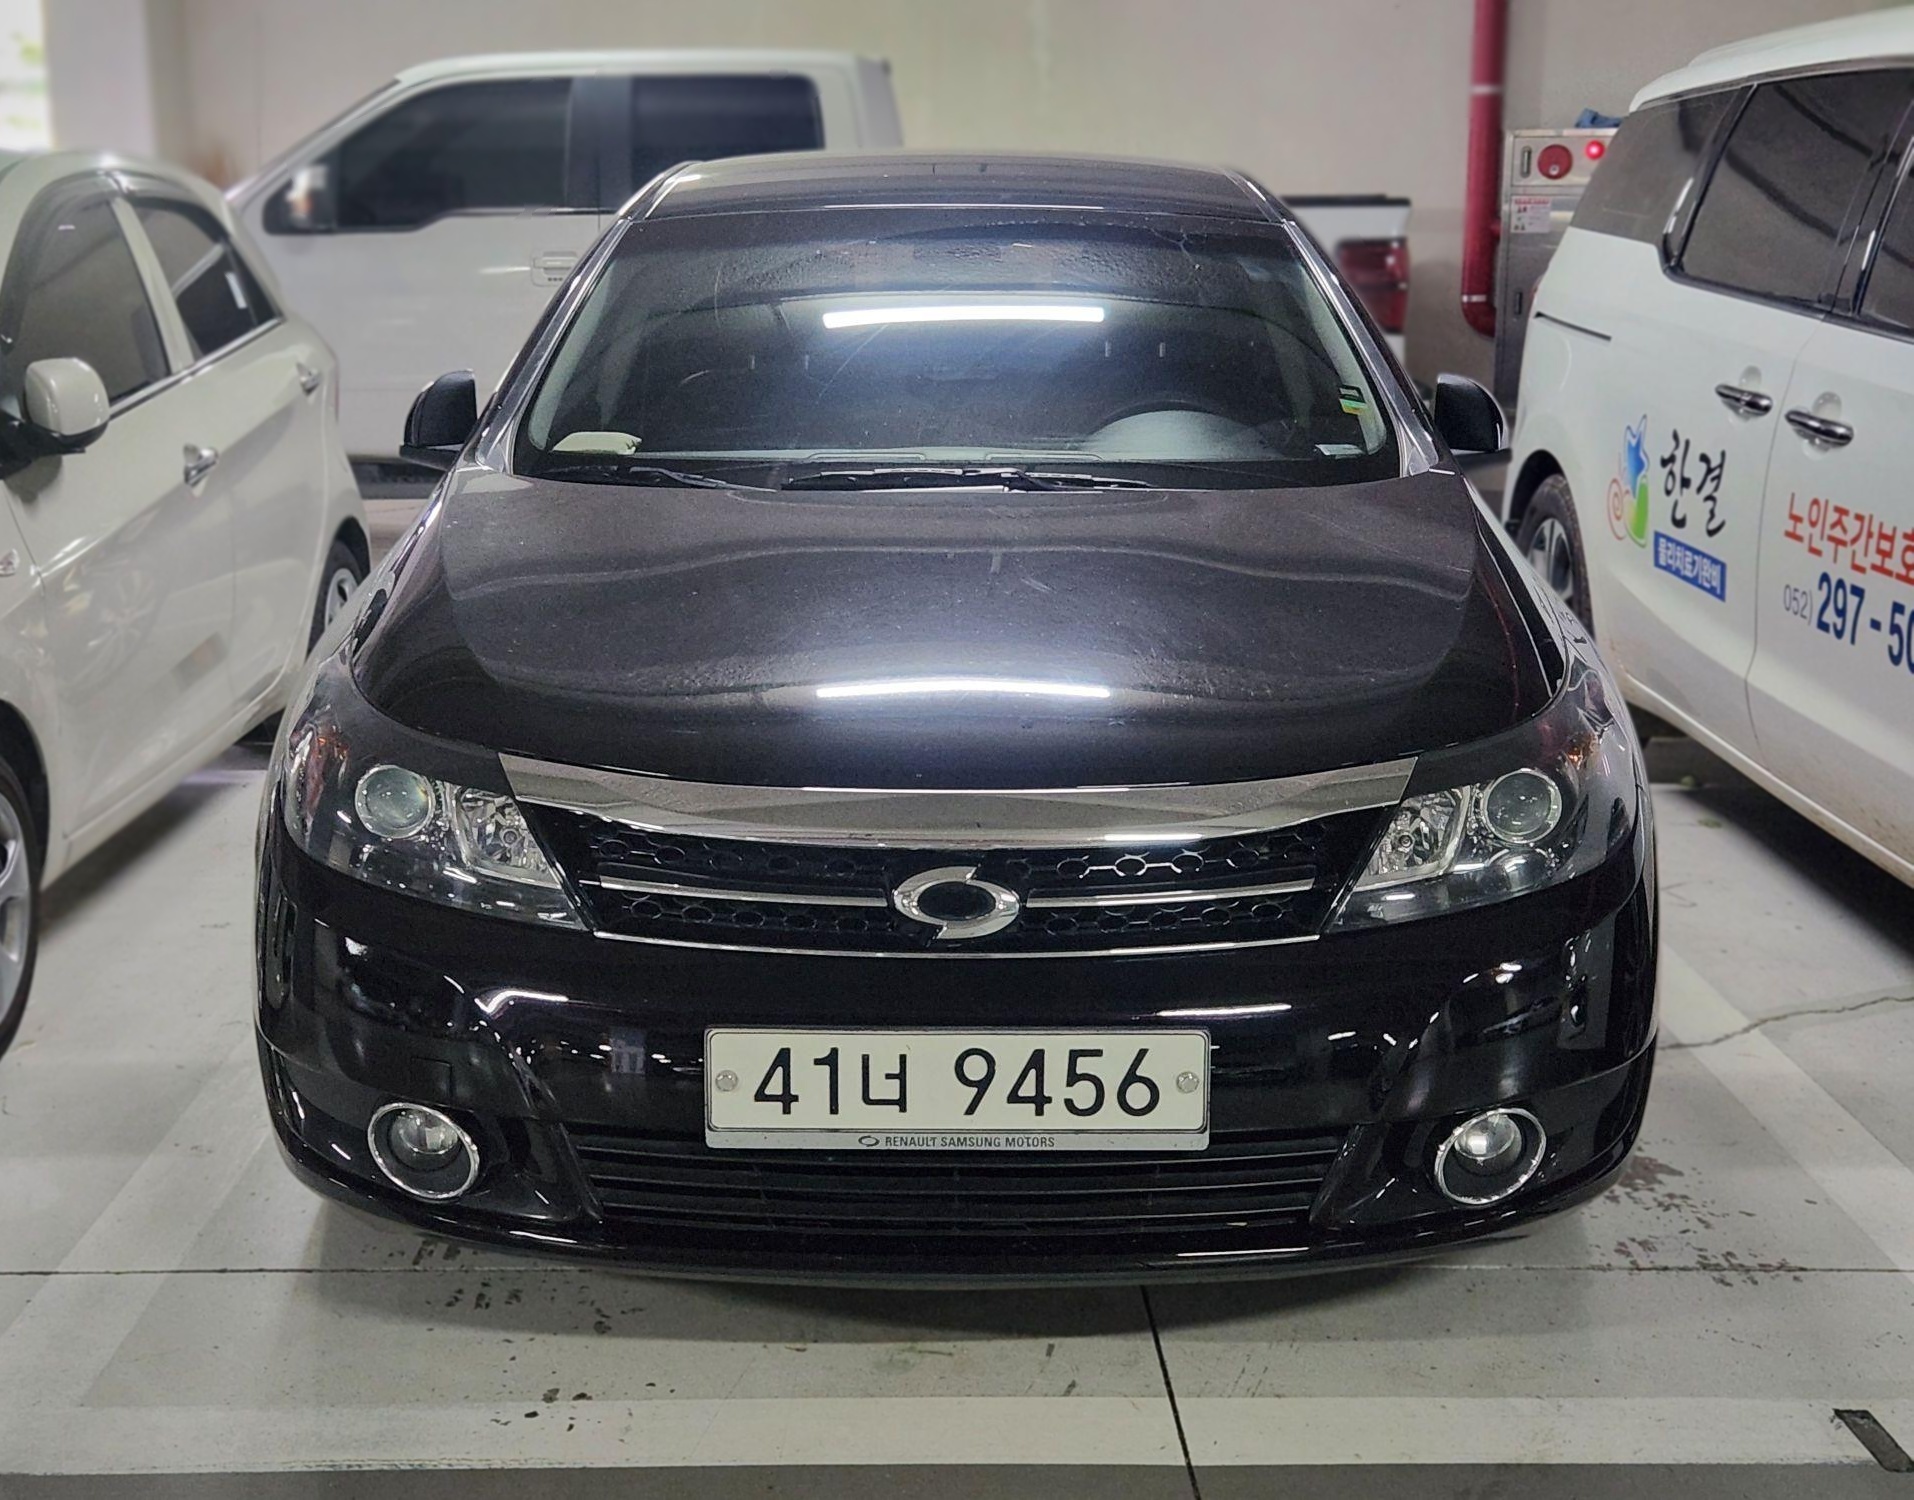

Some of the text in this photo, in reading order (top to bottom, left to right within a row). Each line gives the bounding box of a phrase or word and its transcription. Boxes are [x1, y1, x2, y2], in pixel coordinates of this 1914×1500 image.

[1660, 429, 1726, 538] 한결
[754, 1047, 1160, 1117] 41너 9456
[885, 1136, 1055, 1148] RENAULT SAMSUNG MOTORS
